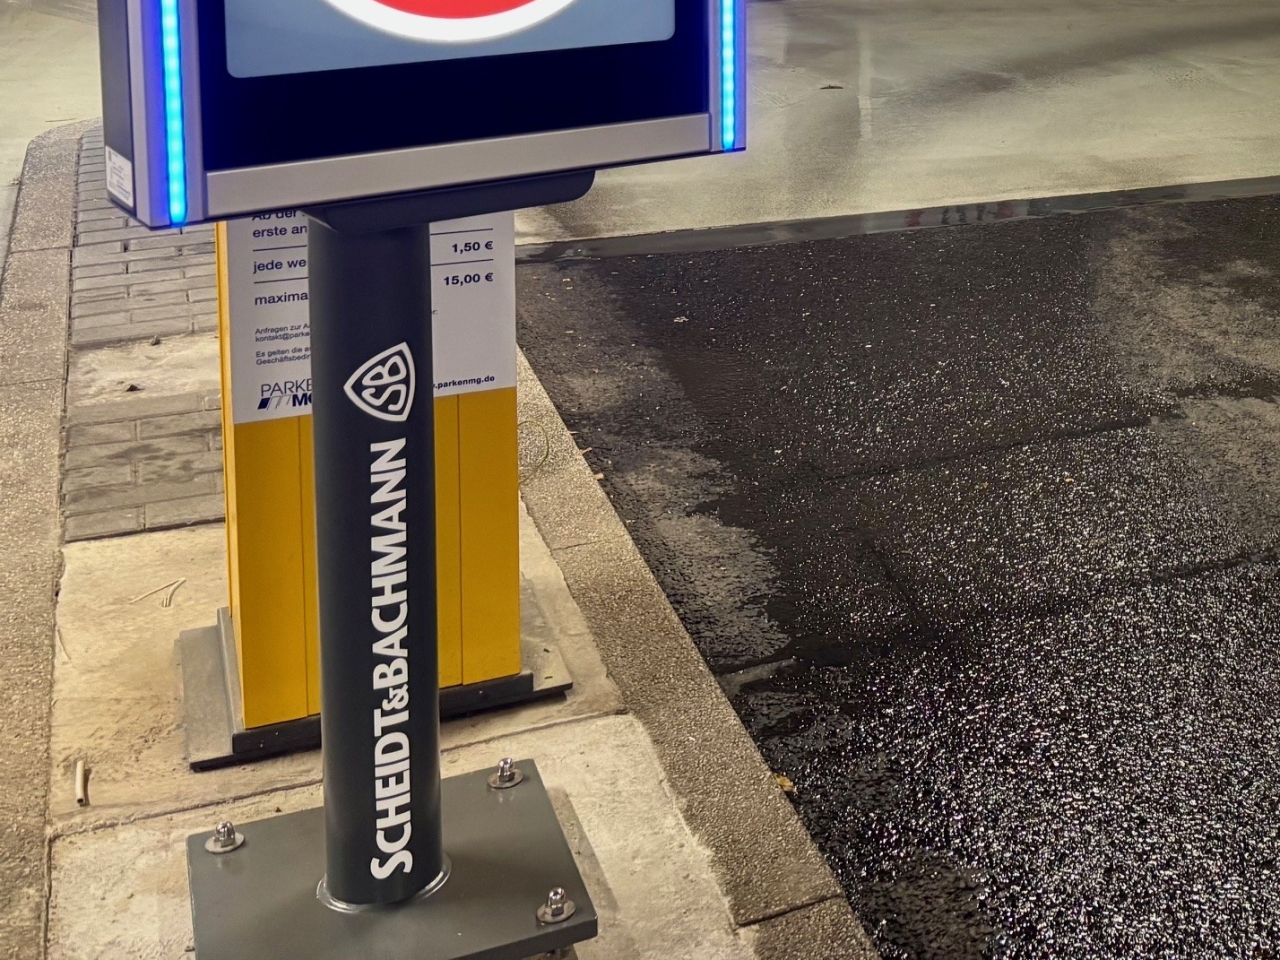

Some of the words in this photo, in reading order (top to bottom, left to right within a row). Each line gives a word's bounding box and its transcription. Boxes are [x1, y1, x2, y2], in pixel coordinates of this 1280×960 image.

[252, 226, 287, 238] erste
[451, 242, 480, 254] 1,50
[485, 241, 493, 250] €
[253, 259, 283, 274] jede
[443, 273, 480, 286] 15,00
[485, 272, 493, 282] €
[370, 438, 412, 879] SCHEIDT&BACHMANN
